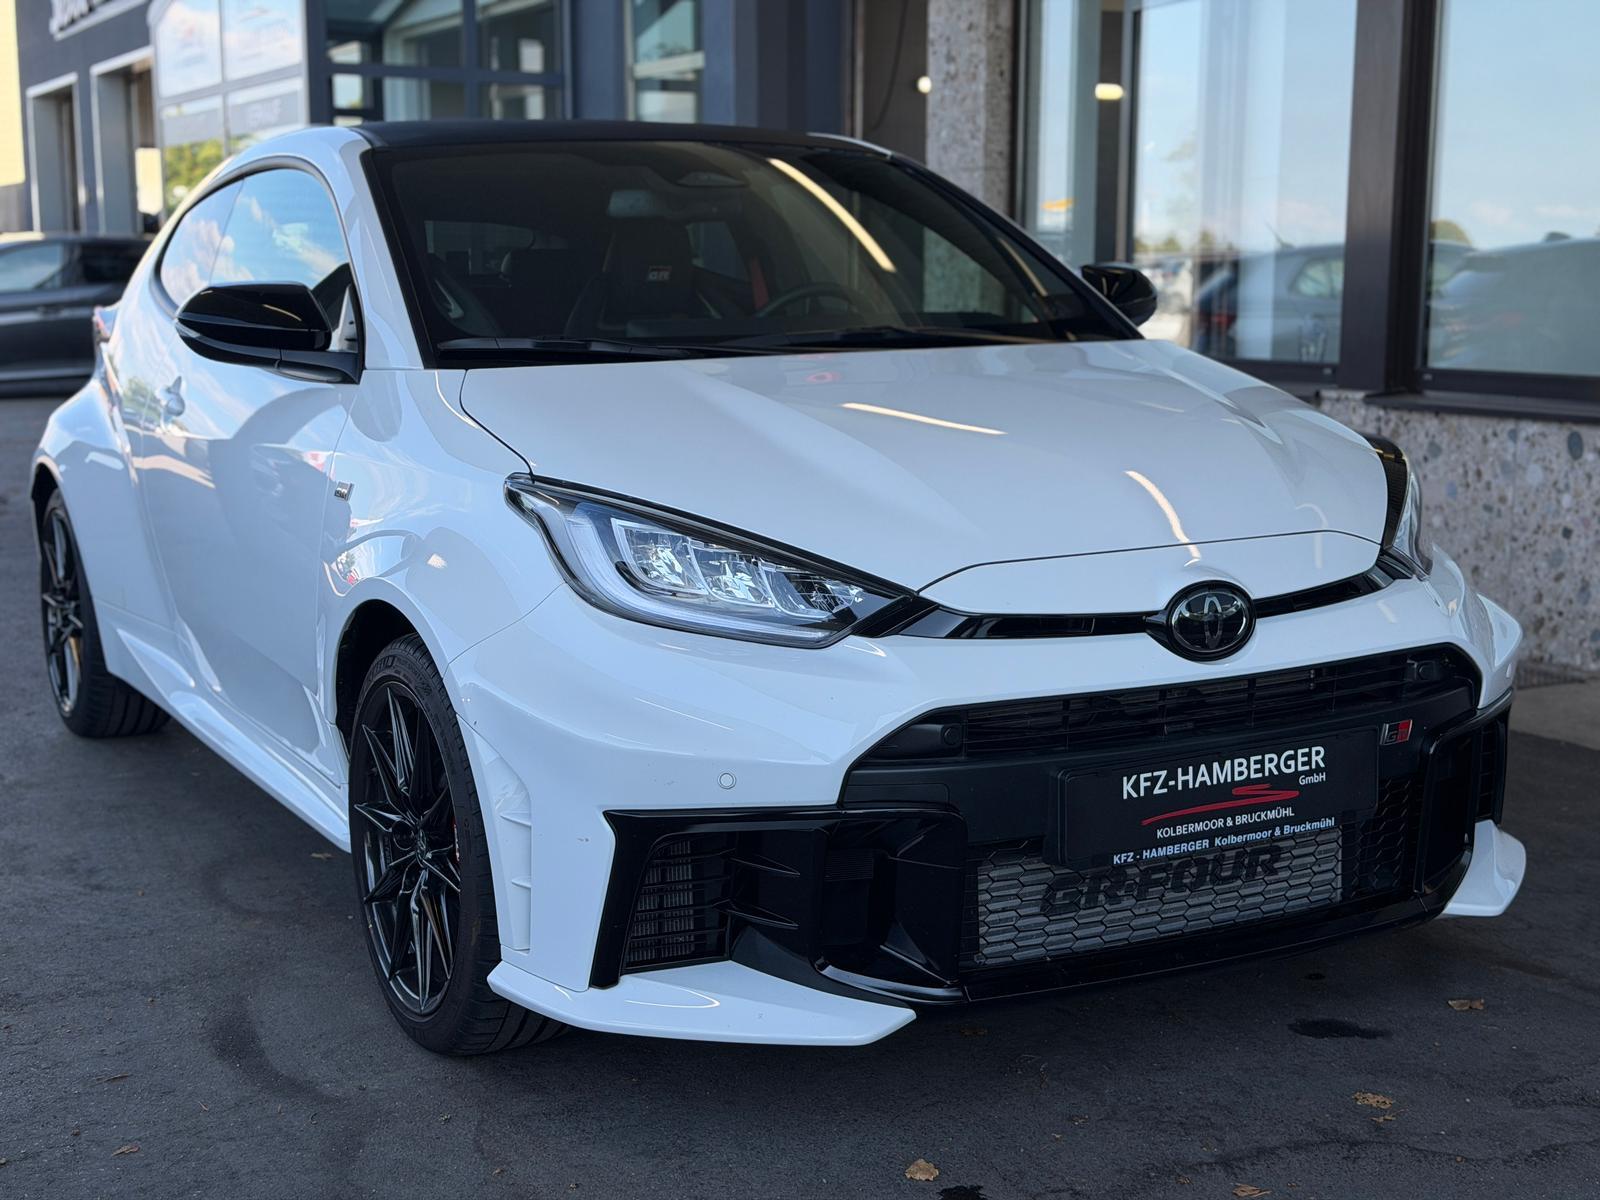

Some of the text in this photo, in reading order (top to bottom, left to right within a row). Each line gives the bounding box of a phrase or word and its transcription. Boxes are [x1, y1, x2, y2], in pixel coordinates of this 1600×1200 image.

[1122, 746, 1325, 800] KFZ-HAMBERGER
[1299, 772, 1327, 786] GmbH
[1113, 850, 1134, 865] KFZ
[1142, 838, 1210, 860] HAMBERGER
[1214, 827, 1273, 847] Kolbermoor
[1274, 826, 1281, 837] &
[1283, 816, 1335, 835] Bruckmühl
[1156, 806, 1295, 839] KOLBERMOOR & BRUCKMÜHL
